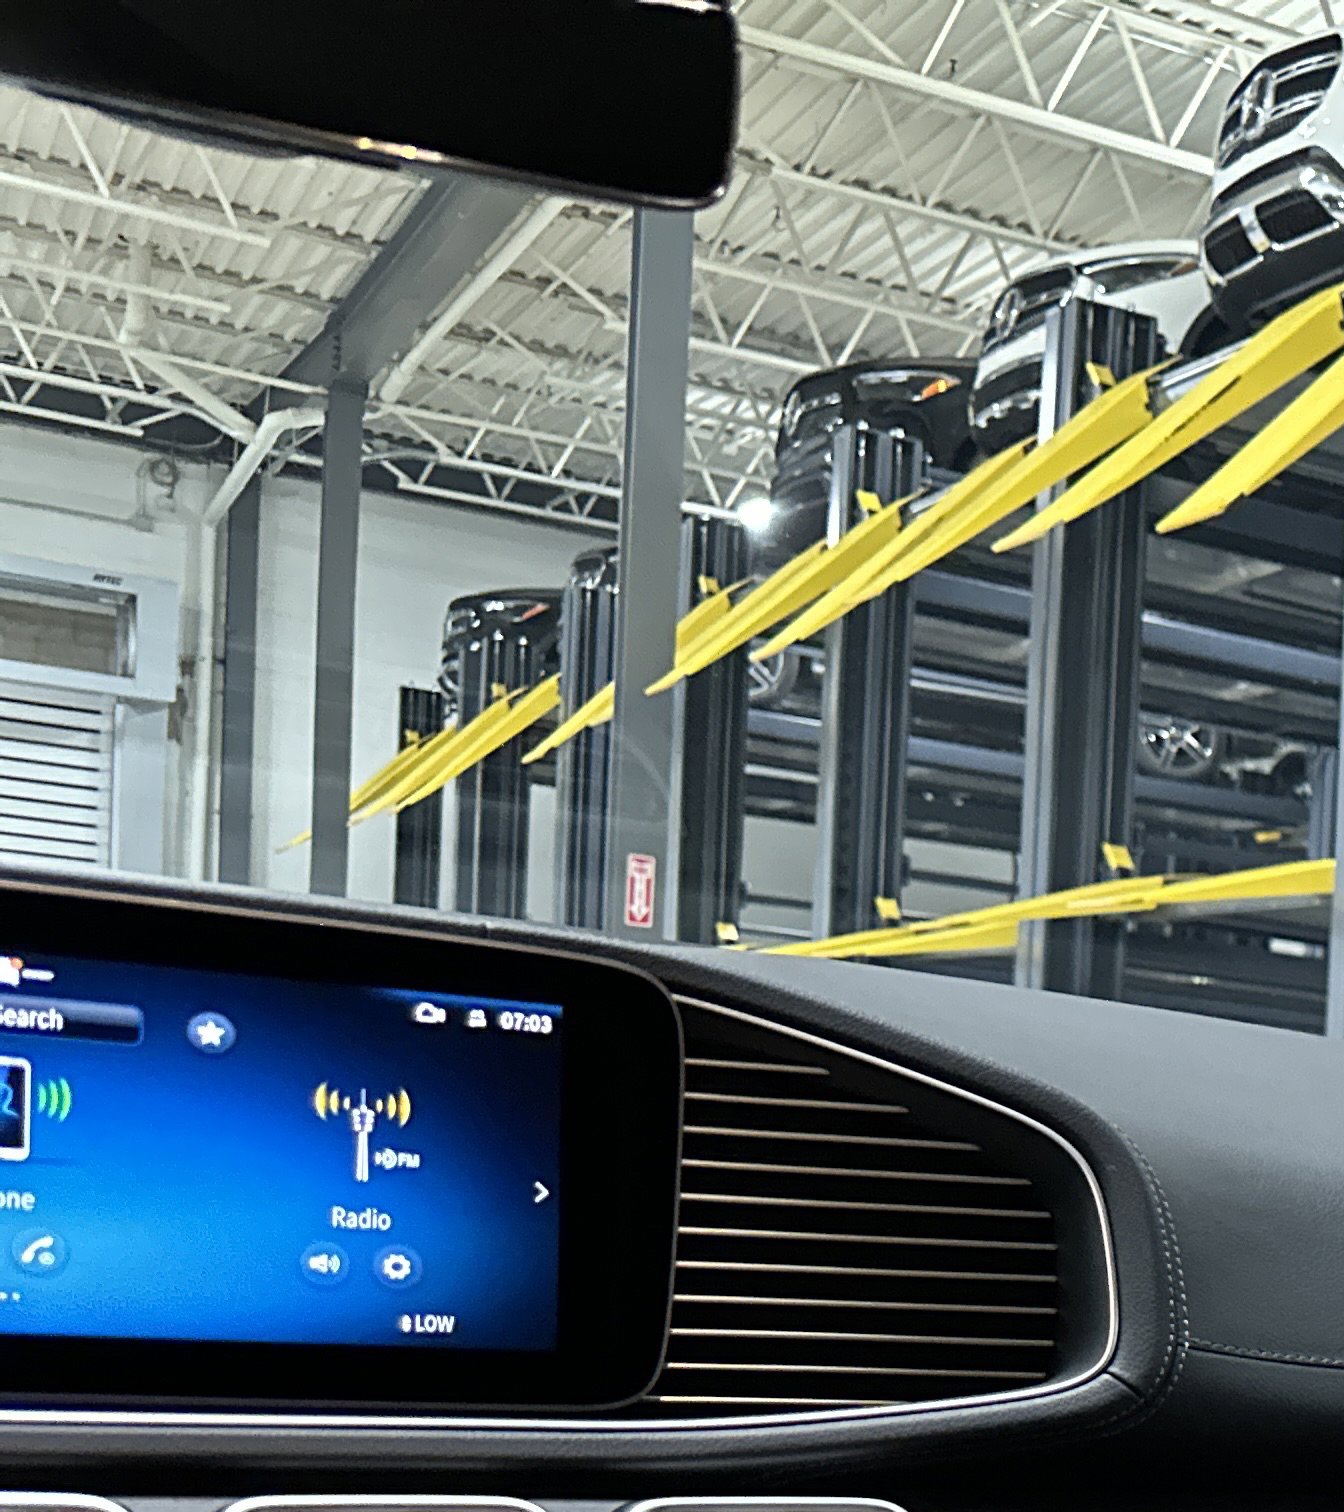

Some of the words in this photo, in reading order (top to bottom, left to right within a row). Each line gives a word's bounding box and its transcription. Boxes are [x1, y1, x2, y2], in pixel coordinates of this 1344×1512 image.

[500, 1011, 552, 1034] 07:03
[331, 1205, 392, 1231] Radio
[415, 1314, 455, 1333] LOW
